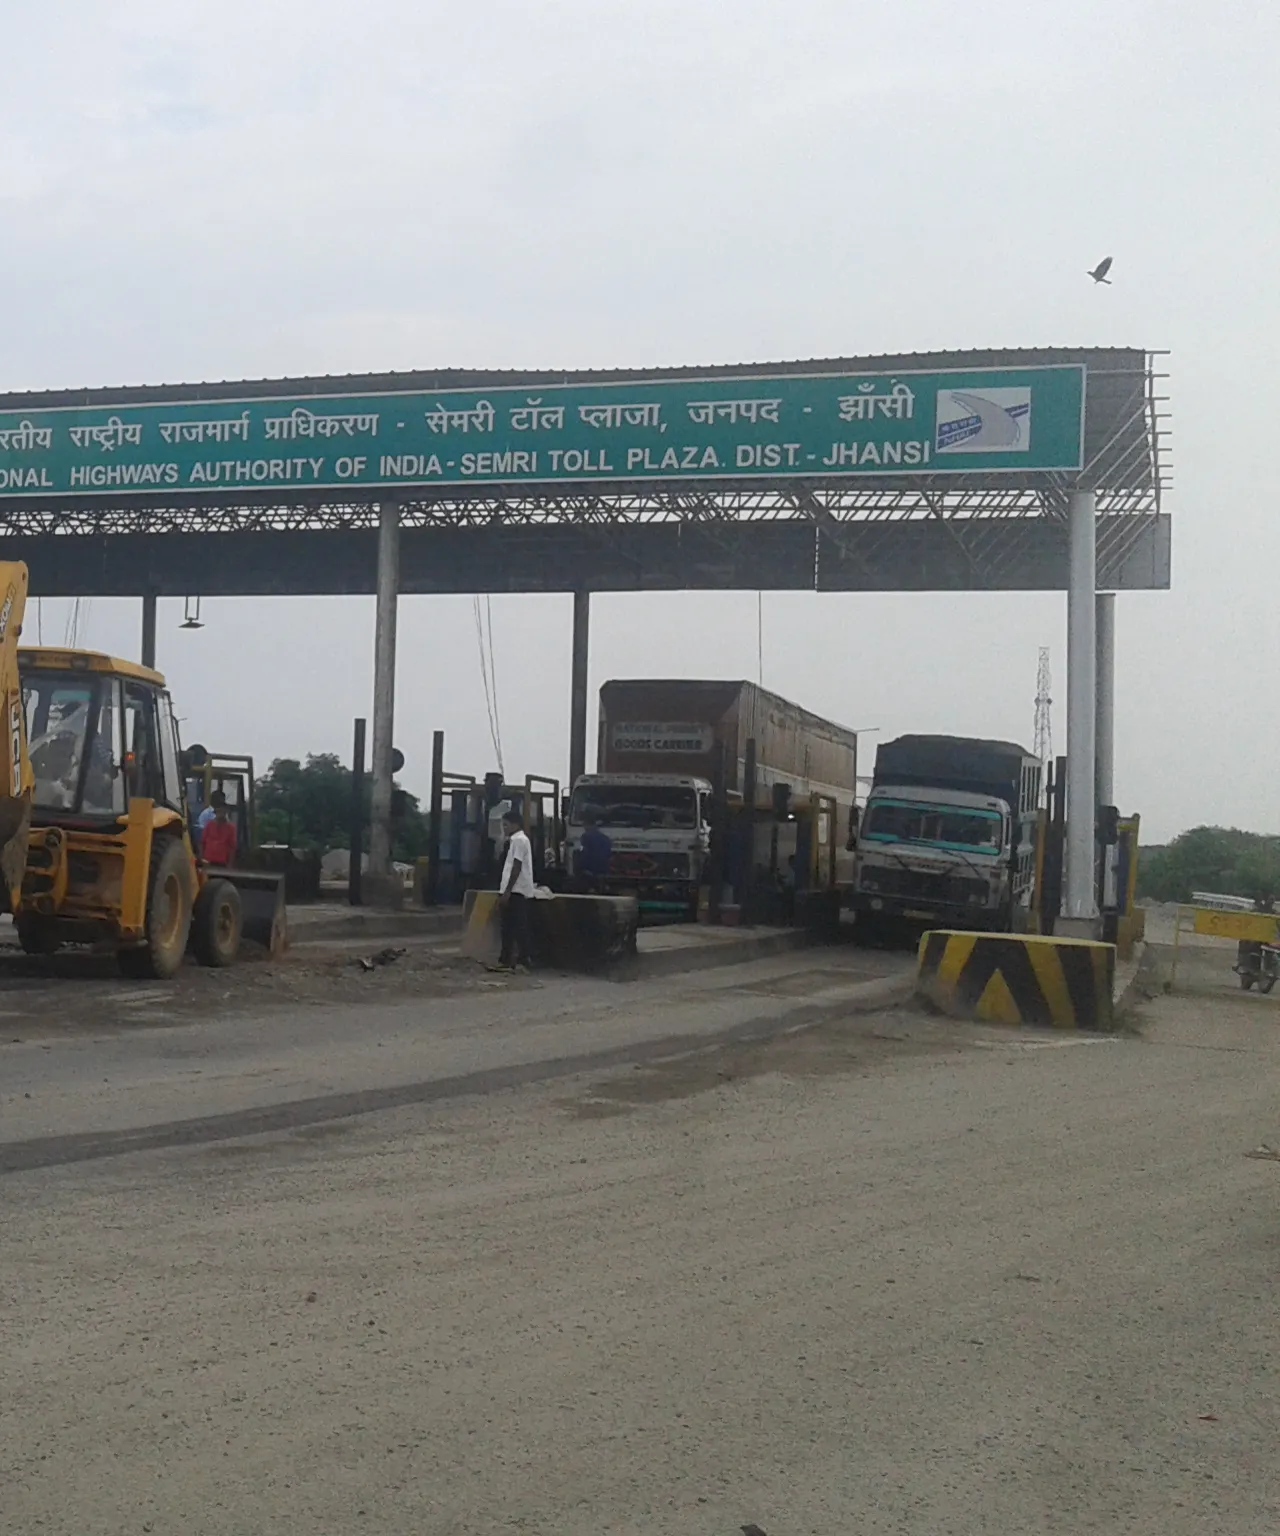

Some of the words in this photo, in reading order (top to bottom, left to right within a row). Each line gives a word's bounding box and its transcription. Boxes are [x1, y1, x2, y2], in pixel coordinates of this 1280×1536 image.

[69, 416, 143, 451] राष्ट्रीय
[159, 410, 251, 443] राजमार्ग
[264, 407, 379, 439] प्राधिकरण
[424, 400, 495, 434] सेमरी
[509, 397, 565, 430] टॉल
[686, 398, 783, 425] जनपद
[71, 463, 179, 486] HIGHWAYS
[189, 457, 324, 483] AUTHORITY
[335, 456, 367, 477] OF
[548, 449, 613, 472] TOLL
[10, 700, 21, 797] JCB
